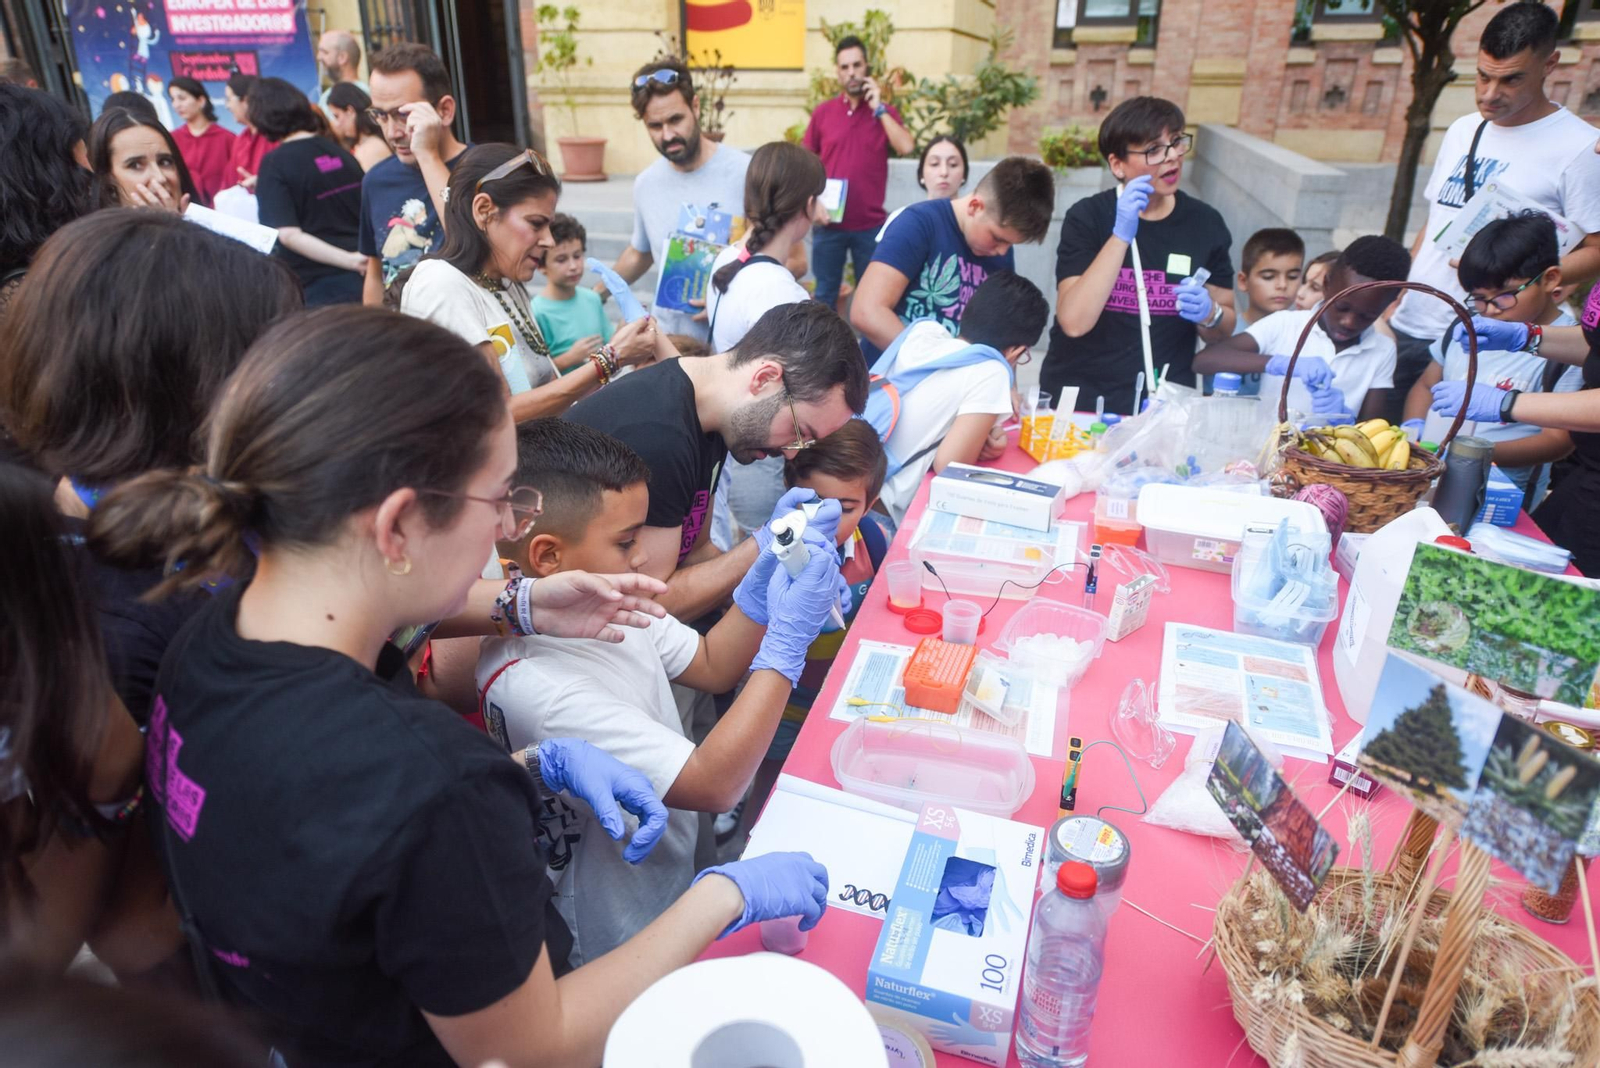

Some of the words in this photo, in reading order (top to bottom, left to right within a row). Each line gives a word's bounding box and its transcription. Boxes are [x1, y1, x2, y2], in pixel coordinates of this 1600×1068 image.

[171, 13, 292, 33] INVESTIGADOR@S
[1130, 270, 1163, 282] NCHE
[1112, 283, 1154, 295] UROA
[1159, 285, 1173, 295] DE
[923, 807, 946, 830] XS
[980, 954, 1007, 994] 100
[978, 1006, 1003, 1024] XS
